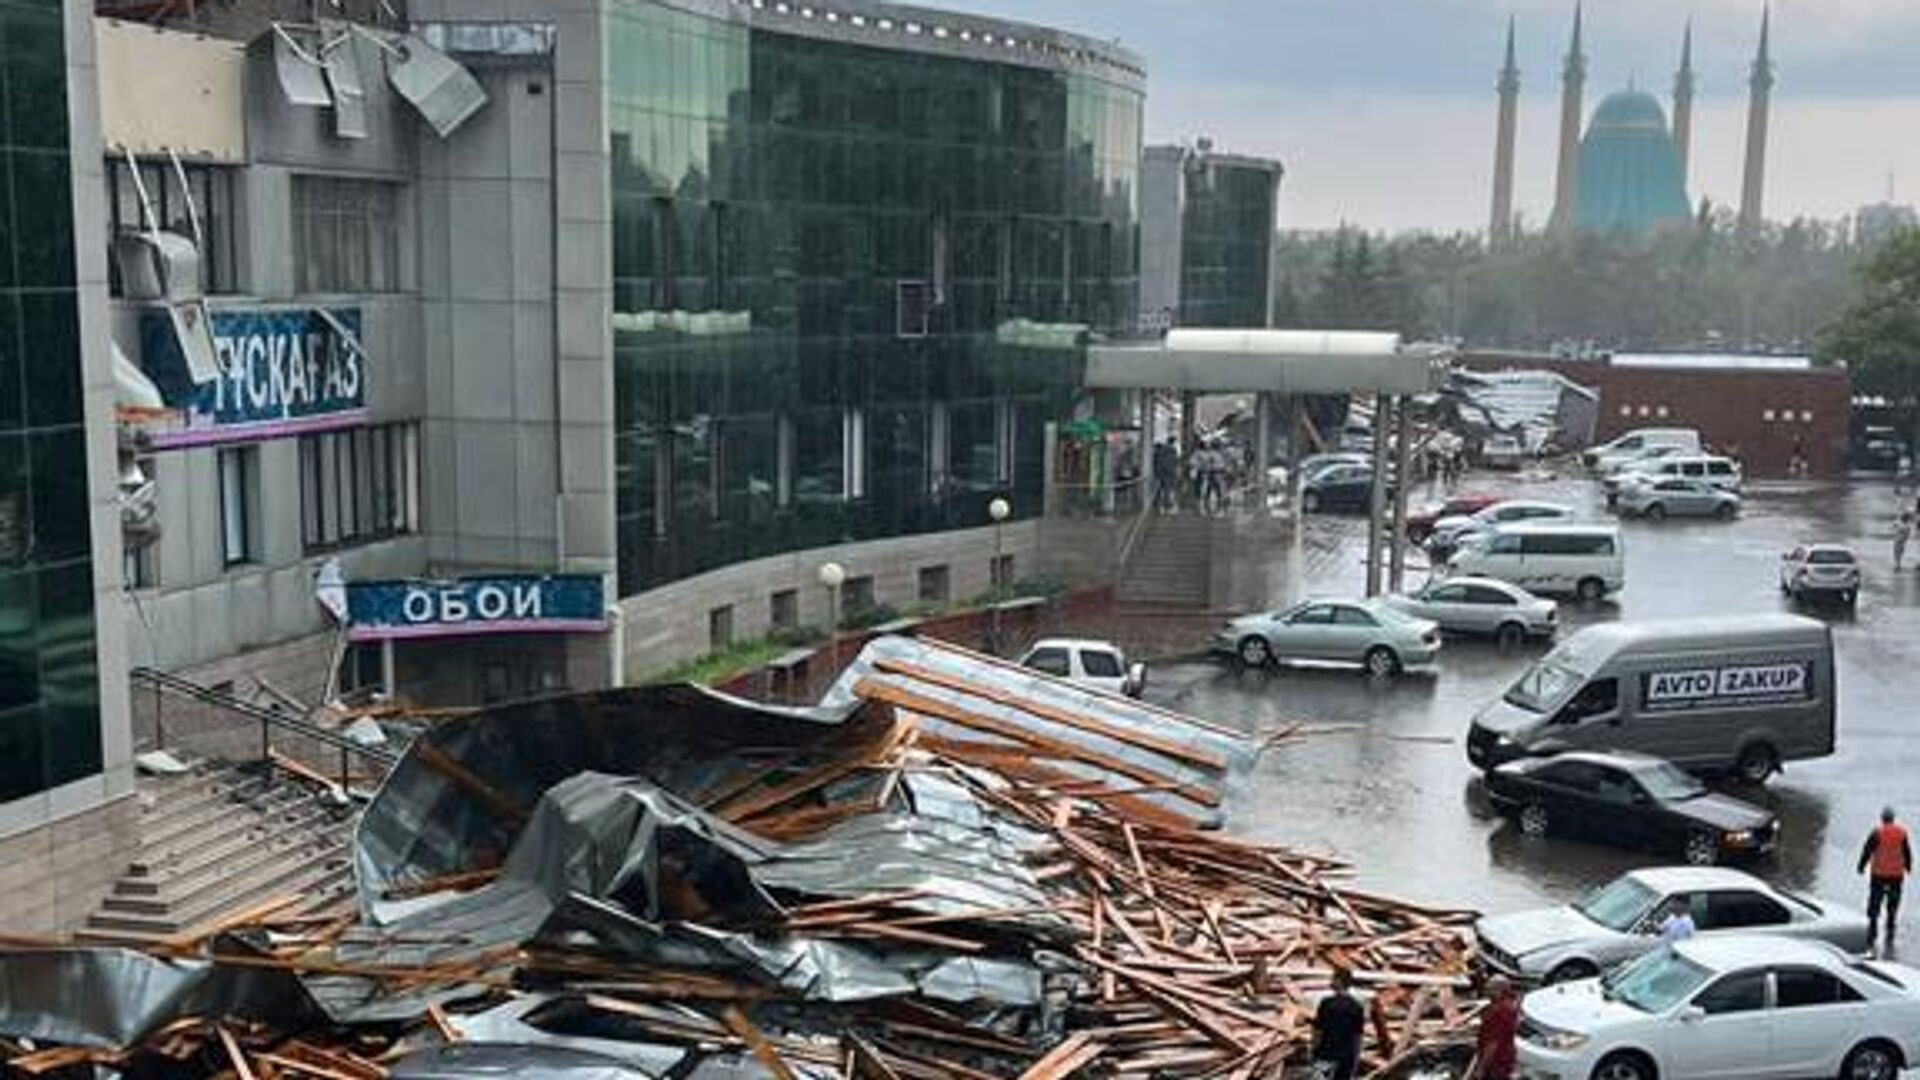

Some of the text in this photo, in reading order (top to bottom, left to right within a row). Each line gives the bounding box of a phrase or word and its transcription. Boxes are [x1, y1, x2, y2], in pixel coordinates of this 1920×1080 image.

[403, 585, 541, 622] ОБОИ
[1654, 668, 1800, 695] AVTO ZAKUP
